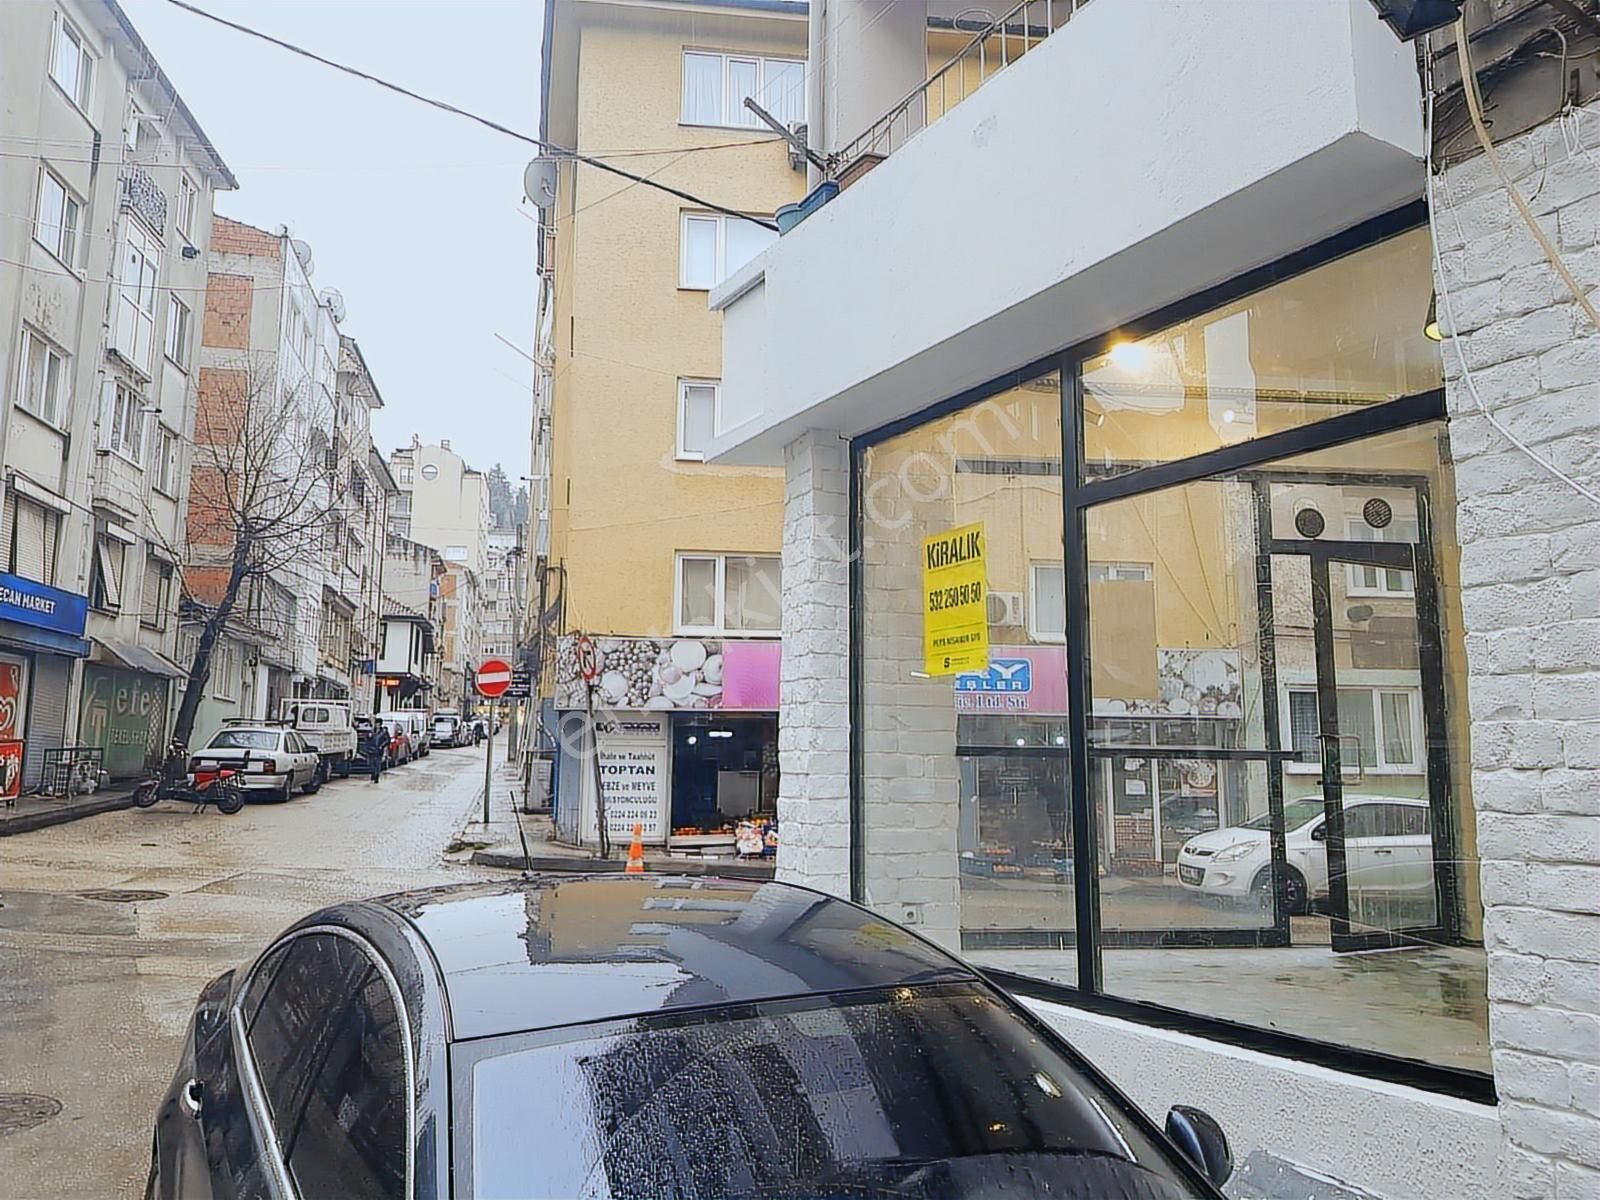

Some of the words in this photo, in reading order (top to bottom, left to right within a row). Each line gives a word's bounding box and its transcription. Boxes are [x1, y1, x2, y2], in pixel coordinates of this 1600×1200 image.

[22, 594, 56, 615] MARKET
[929, 590, 943, 612] 532
[944, 587, 958, 609] 250
[959, 584, 970, 606] 50
[970, 582, 981, 603] 50
[117, 679, 151, 717] efe
[599, 765, 656, 775] TOPTAN
[601, 781, 620, 791] EBZE
